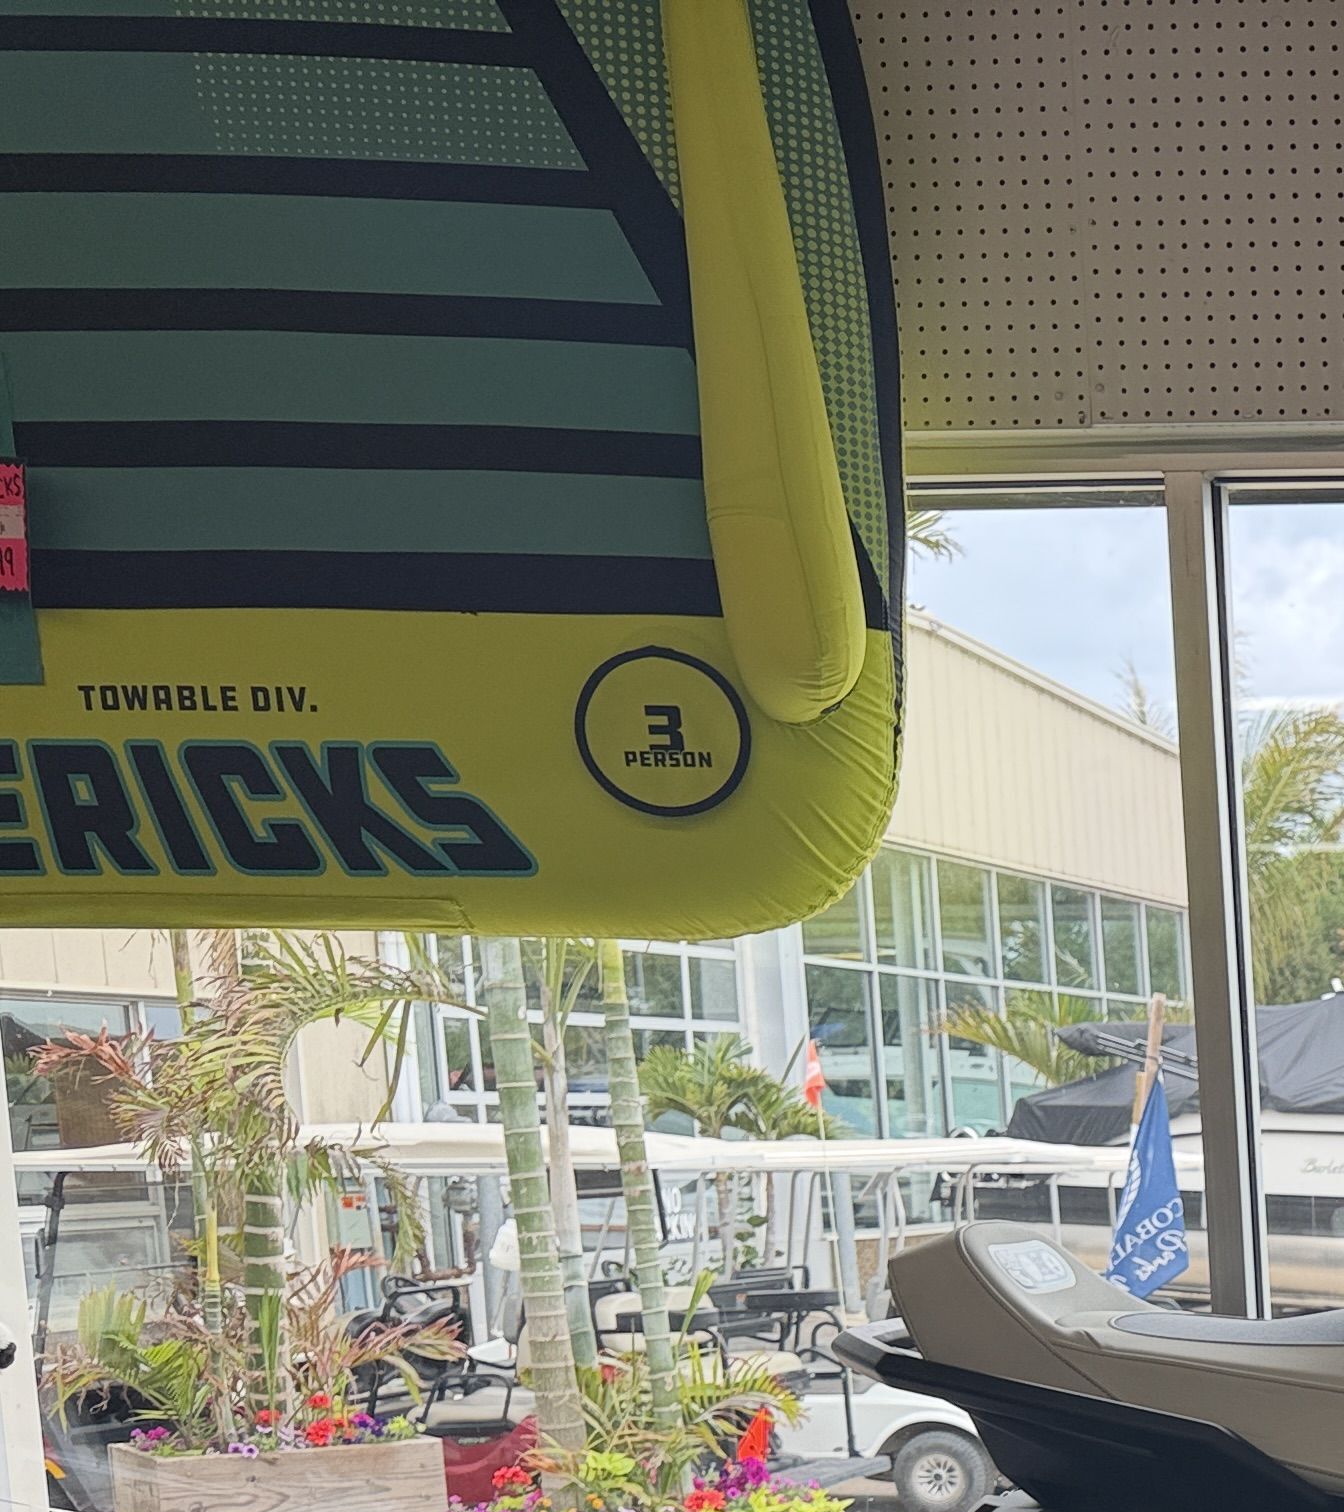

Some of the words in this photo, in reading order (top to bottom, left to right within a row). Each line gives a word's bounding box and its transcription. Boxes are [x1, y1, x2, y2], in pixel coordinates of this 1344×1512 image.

[78, 683, 239, 712] TOWABLE
[251, 686, 319, 713] DIV.
[643, 703, 685, 752] 3
[624, 749, 713, 769] PERSON
